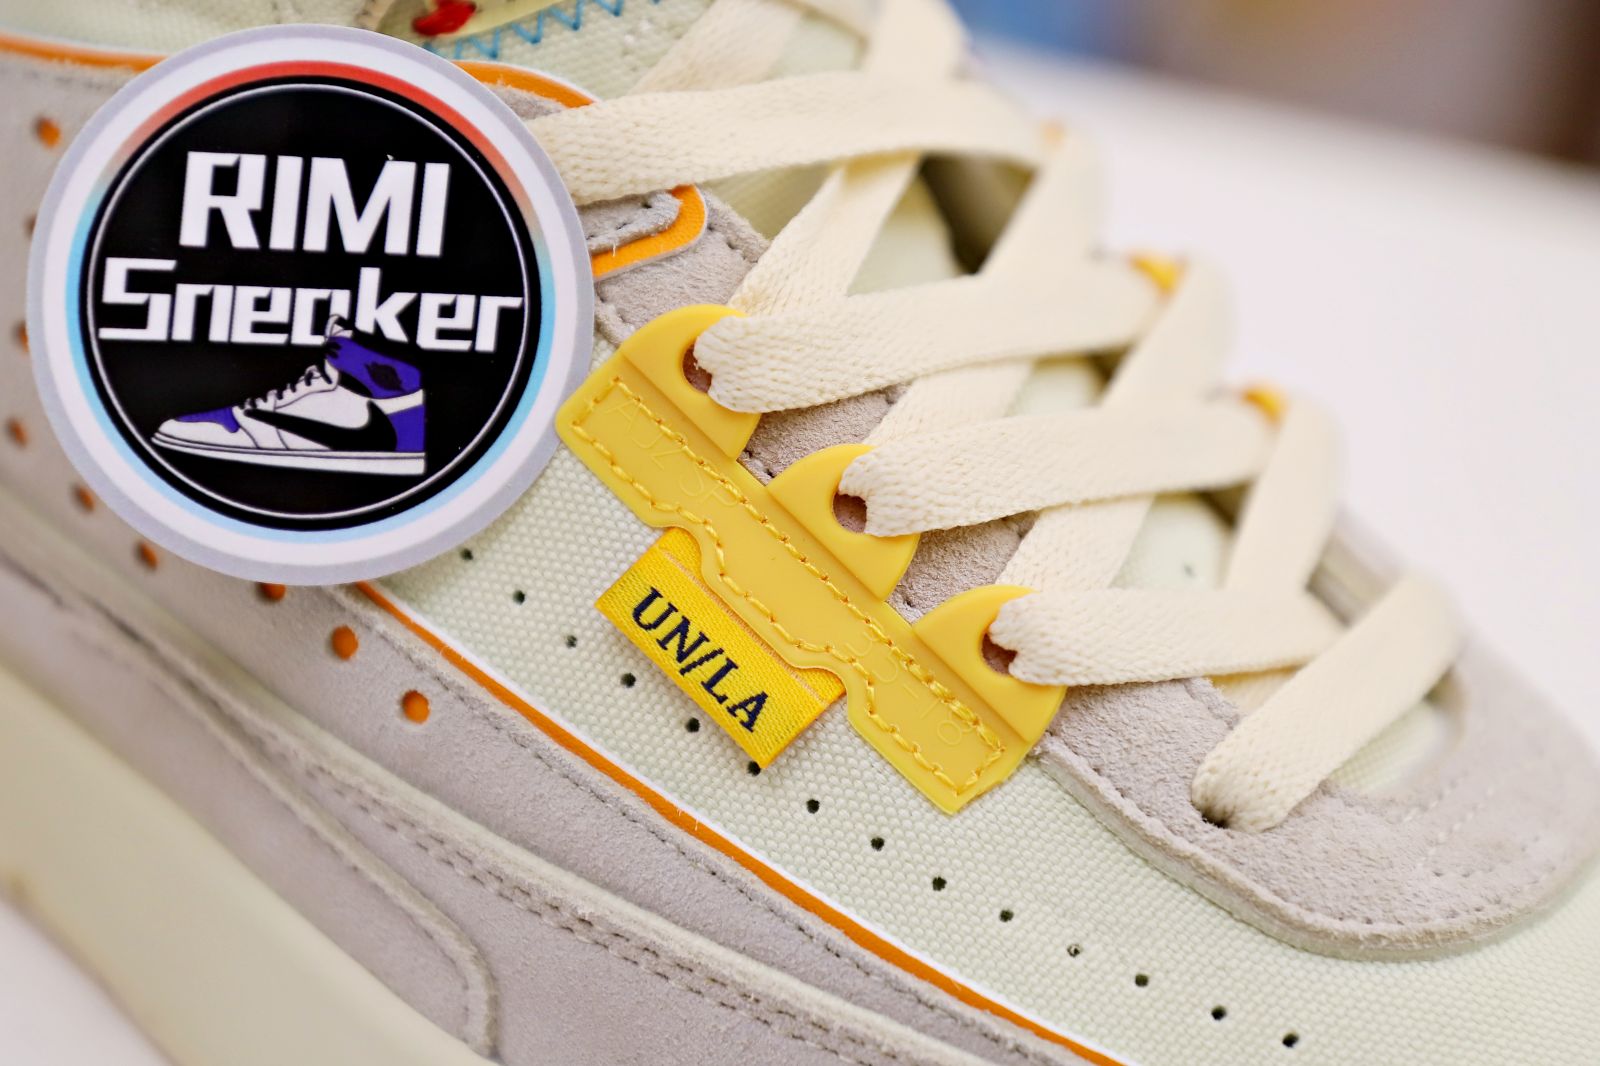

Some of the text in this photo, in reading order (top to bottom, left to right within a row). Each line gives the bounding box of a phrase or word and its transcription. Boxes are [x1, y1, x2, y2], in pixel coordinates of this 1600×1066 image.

[179, 151, 450, 257] RIMI
[98, 257, 524, 353] Sneaker
[632, 586, 768, 732] UN/LA
